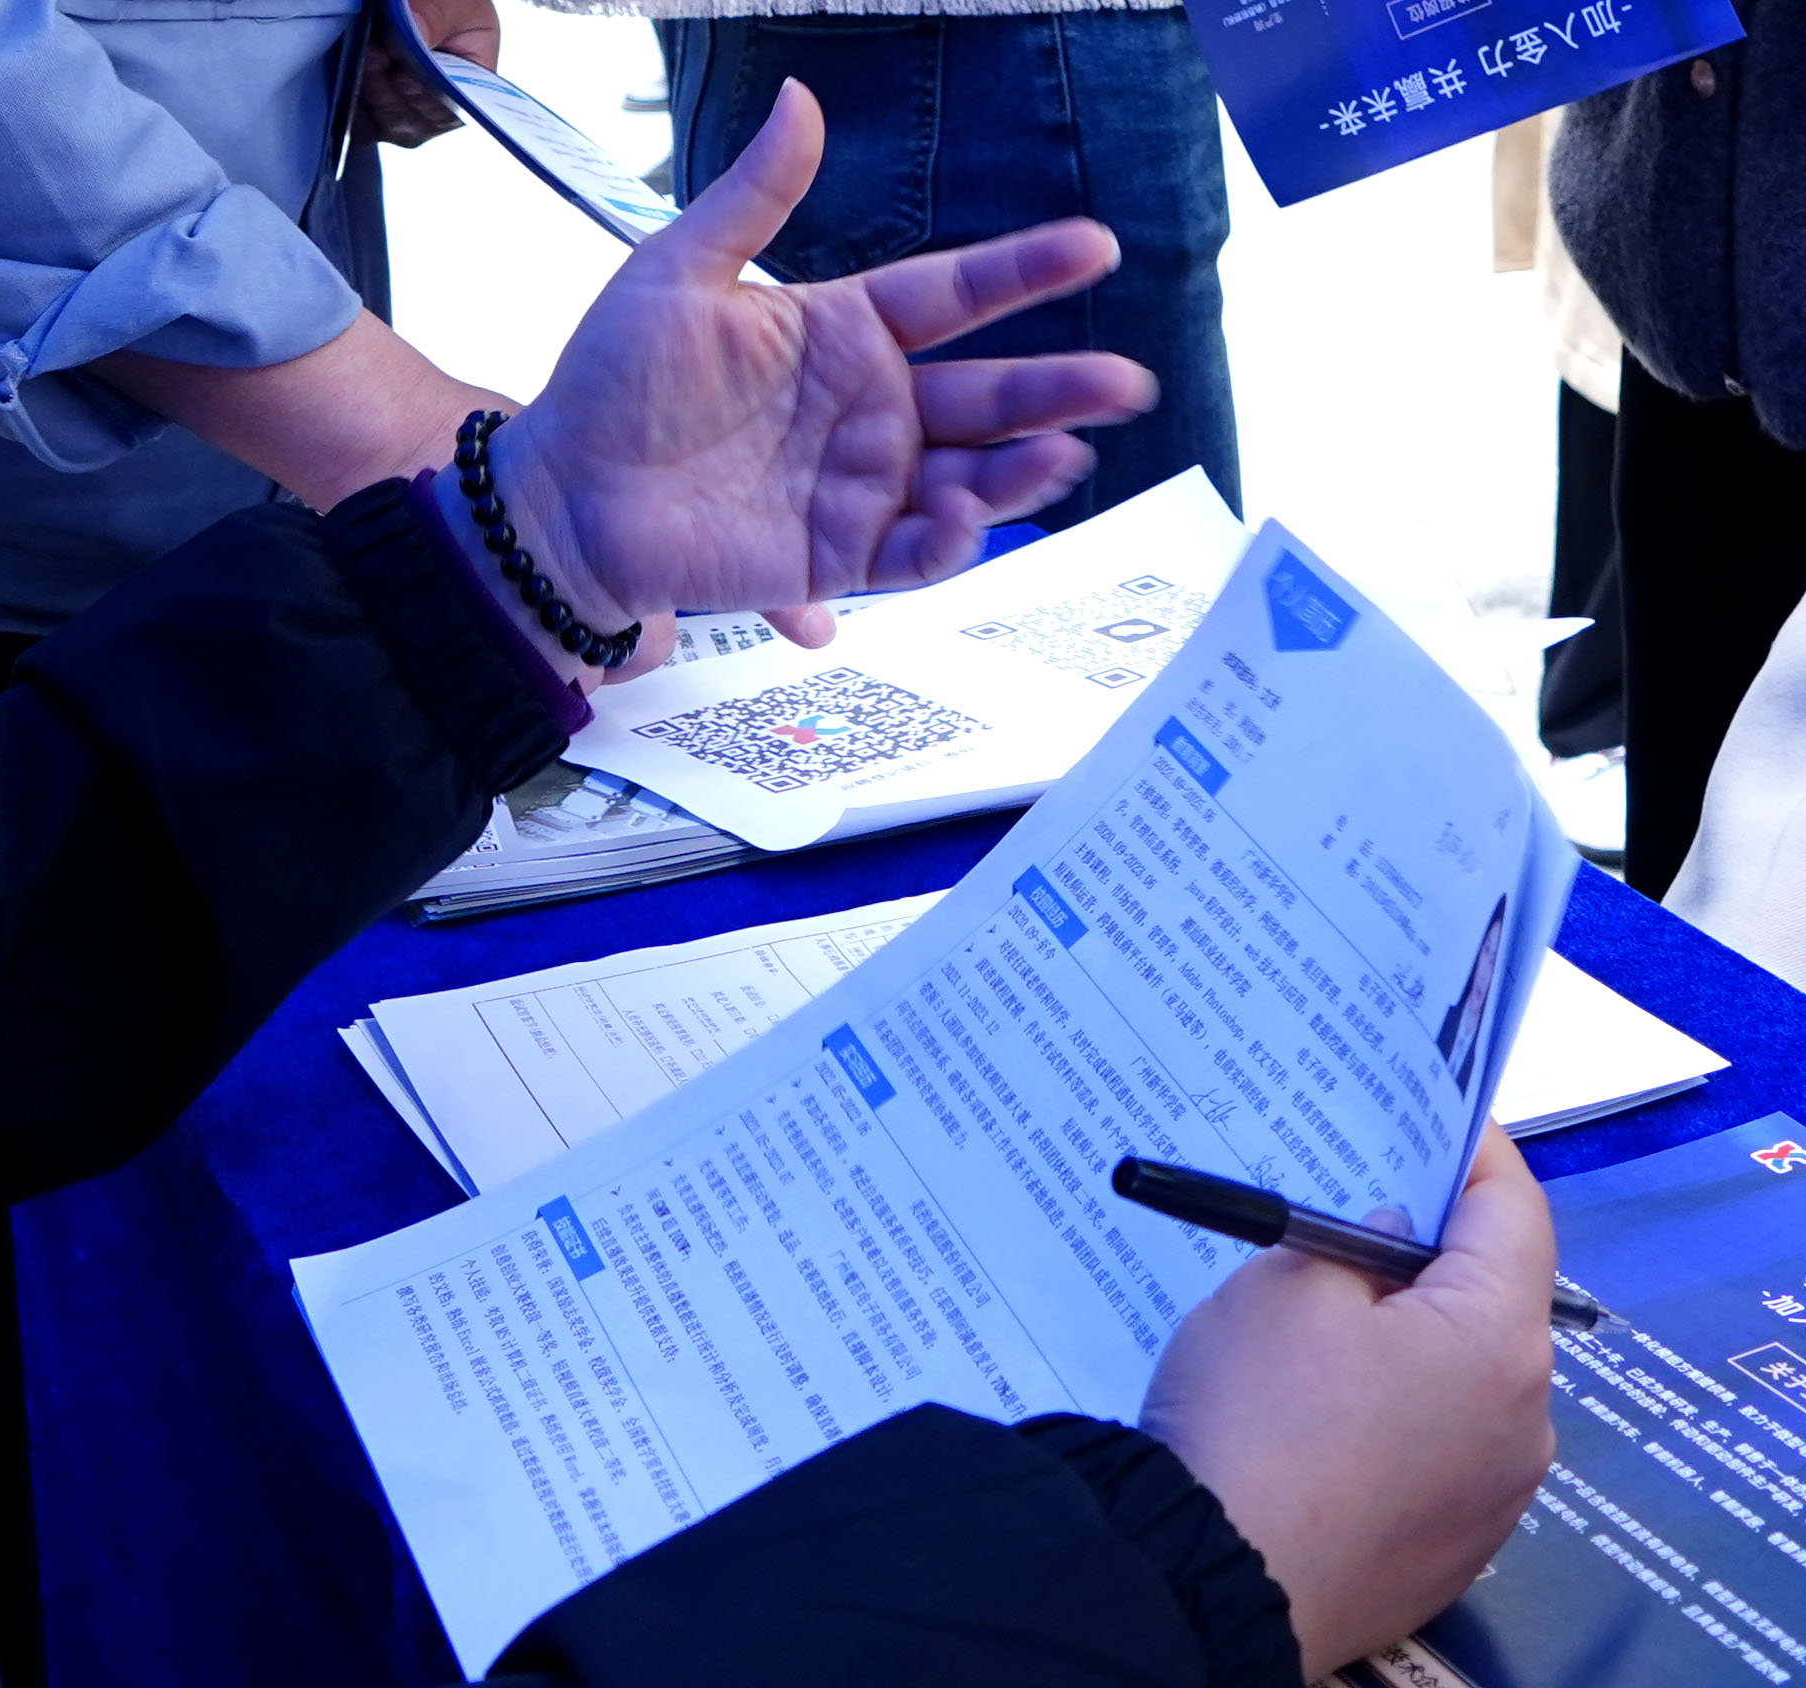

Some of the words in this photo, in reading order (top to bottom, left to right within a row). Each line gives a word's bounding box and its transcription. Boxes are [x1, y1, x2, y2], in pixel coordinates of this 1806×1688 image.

[1314, 57, 1468, 144] 共赢未来-
[1027, 884, 1069, 929] 校园经历
[1005, 904, 1058, 962] 2020.09-至今
[1127, 1054, 1189, 1122] 广州新华学院
[1092, 821, 1158, 890] 2020.09-2023.06
[1177, 915, 1254, 999] 潮汕职业技术学院
[1292, 1045, 1340, 1095] 电子商务
[1378, 1144, 1408, 1173] 大专
[1058, 1116, 1110, 1177] 短视频大赛
[908, 1197, 991, 1309] 美的集团股份有限公司
